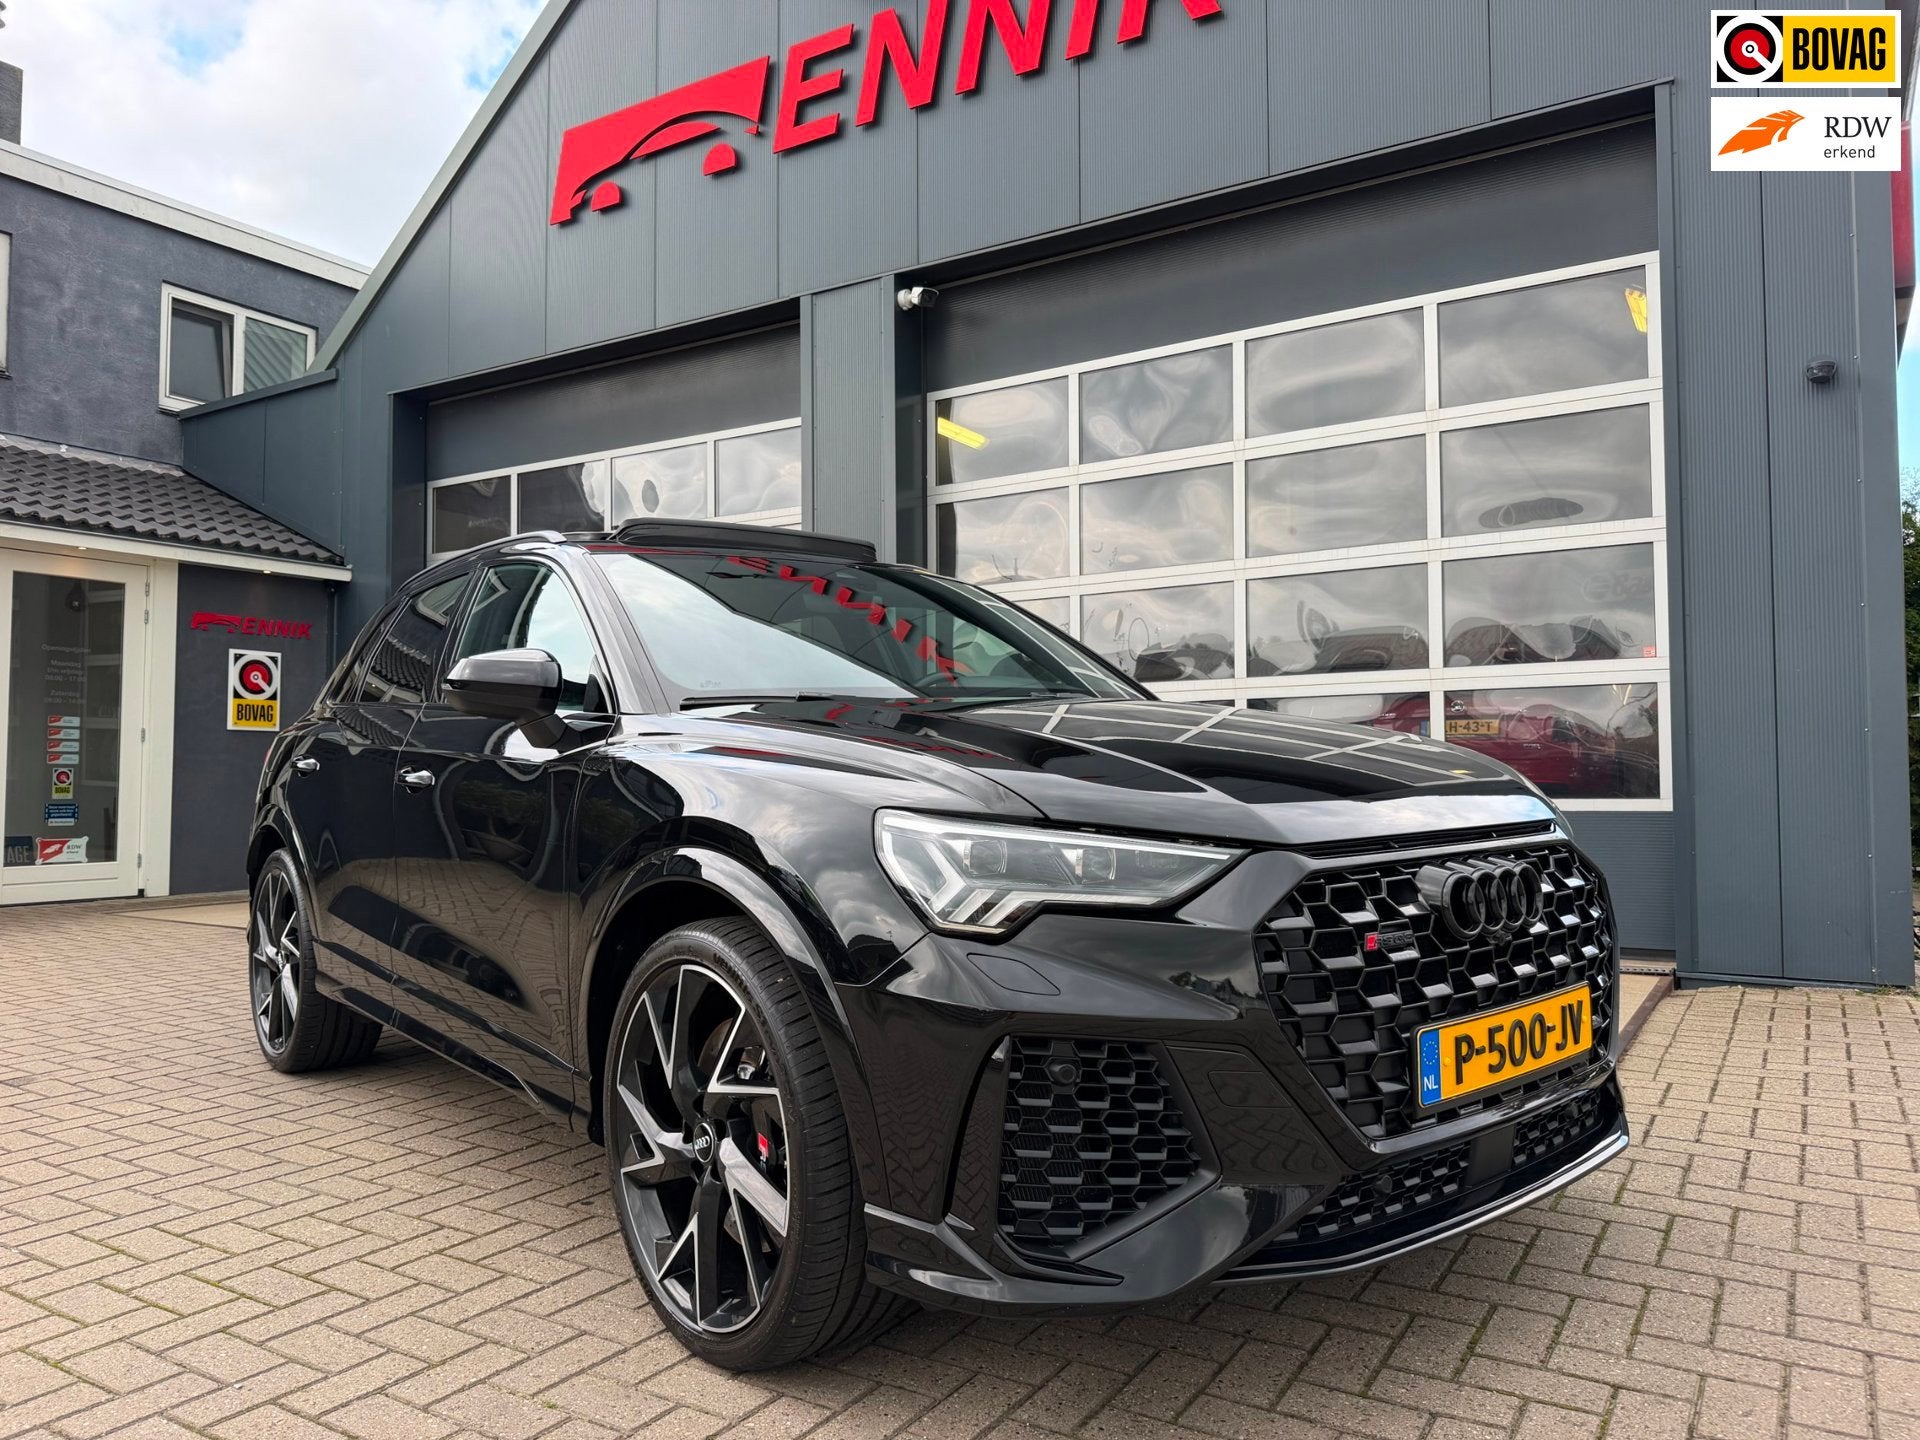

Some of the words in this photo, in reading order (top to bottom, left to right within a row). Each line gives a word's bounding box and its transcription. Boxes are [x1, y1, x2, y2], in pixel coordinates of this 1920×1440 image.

[236, 703, 274, 723] BOVAG
[1445, 719, 1493, 734] H-43-T
[1455, 998, 1584, 1086] P-500-JV
[1423, 1073, 1439, 1092] NL
